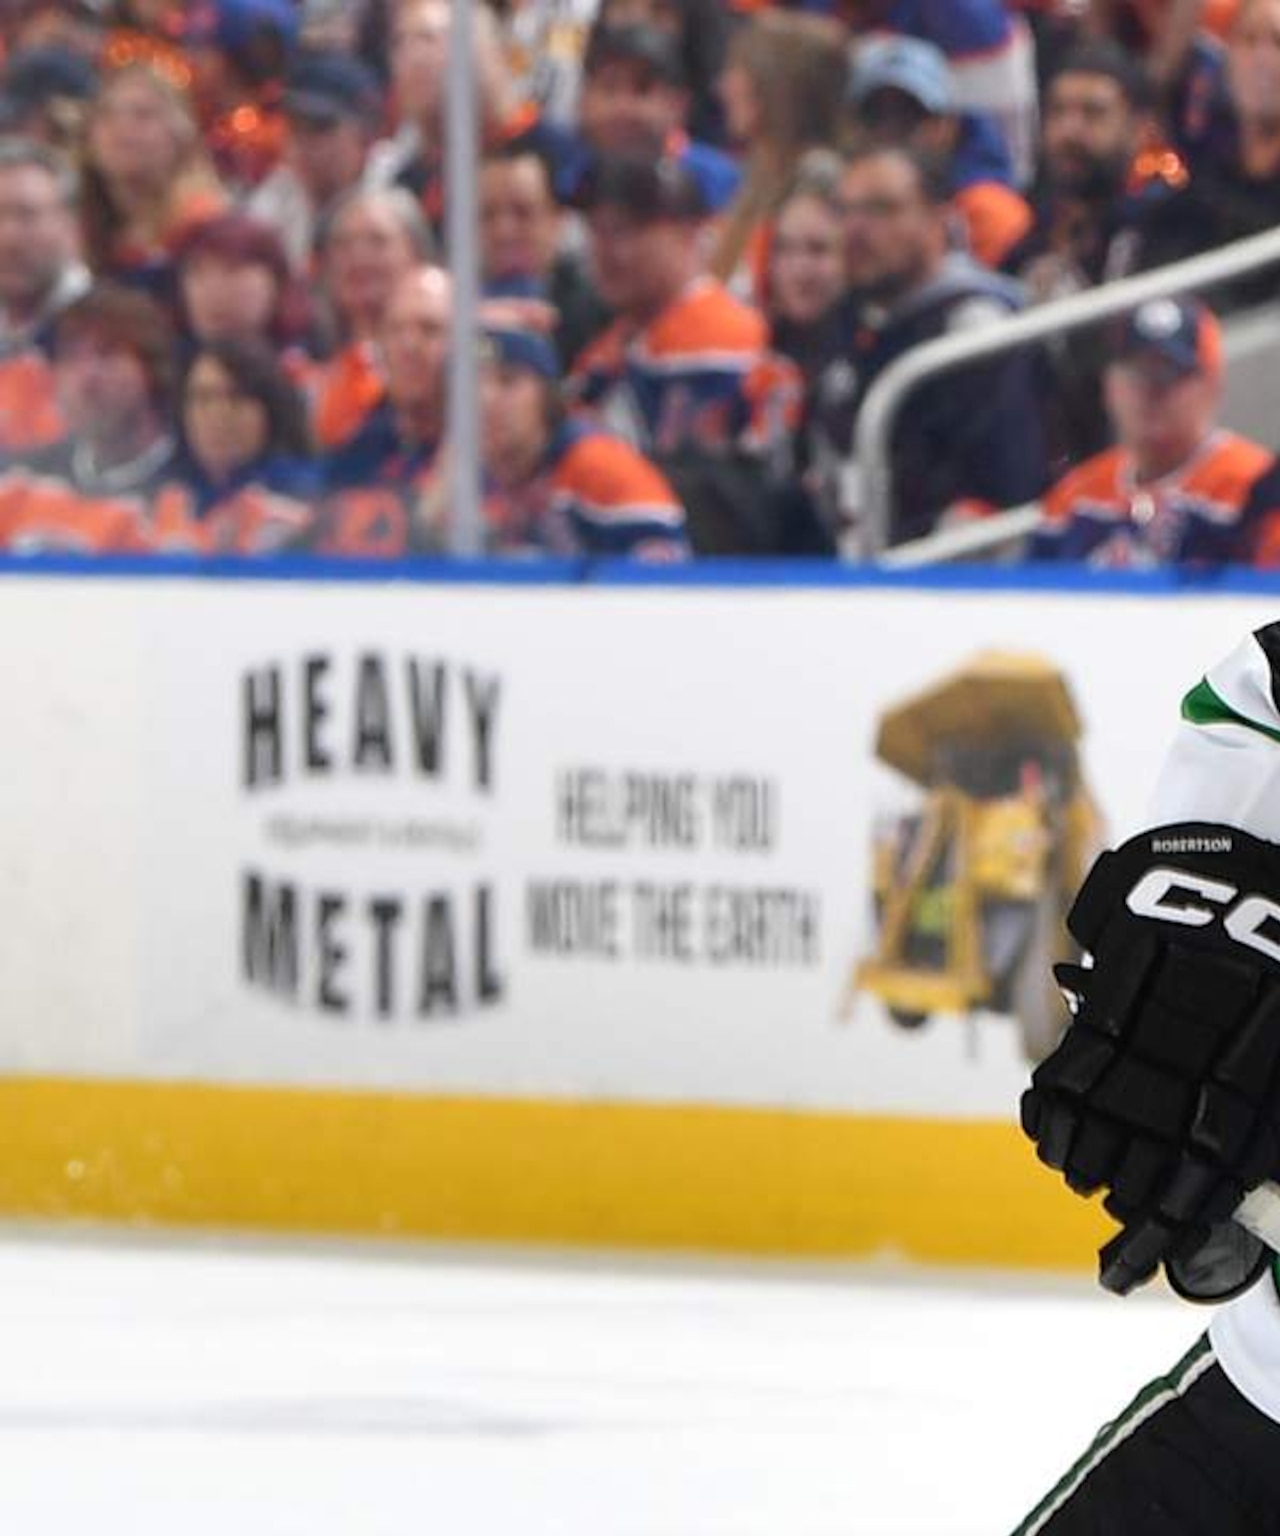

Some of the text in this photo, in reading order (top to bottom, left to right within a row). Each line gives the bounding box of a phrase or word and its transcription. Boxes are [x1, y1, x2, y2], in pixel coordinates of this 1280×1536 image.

[243, 652, 502, 790] HEAVY
[1153, 836, 1233, 853] ROBERTSON
[243, 868, 503, 1018] METAL
